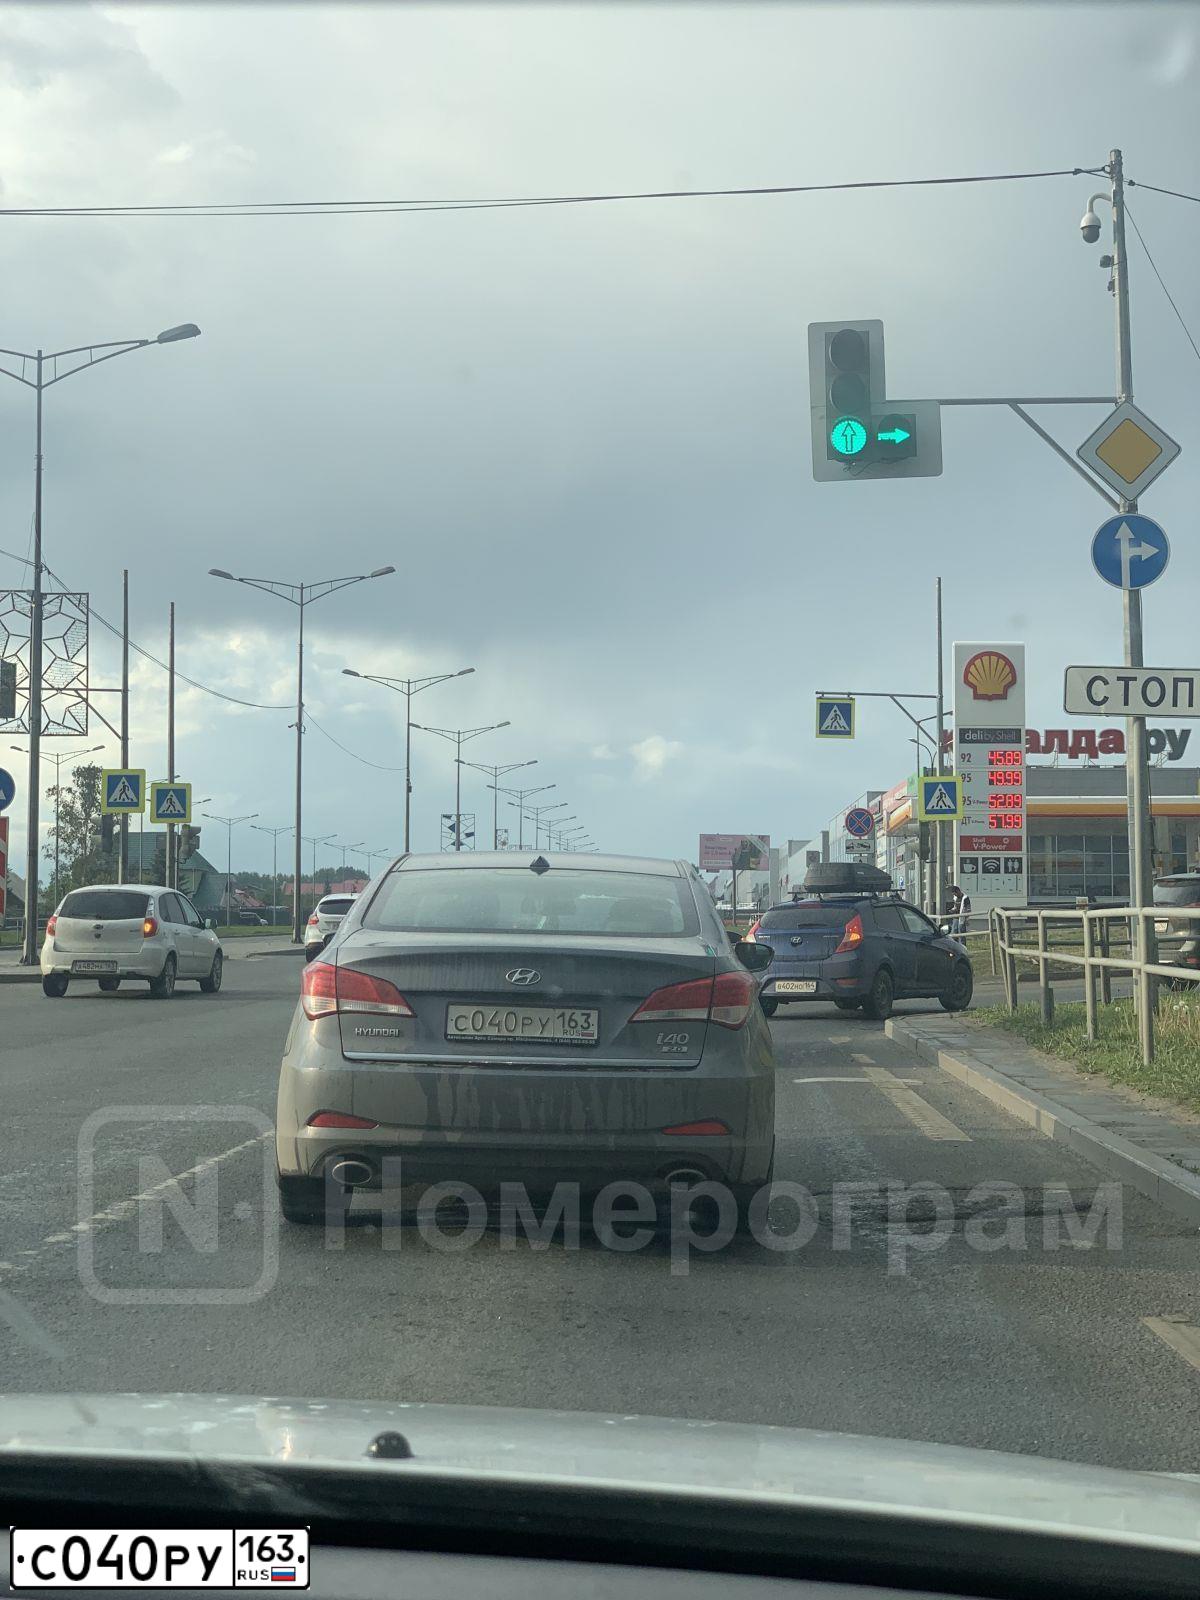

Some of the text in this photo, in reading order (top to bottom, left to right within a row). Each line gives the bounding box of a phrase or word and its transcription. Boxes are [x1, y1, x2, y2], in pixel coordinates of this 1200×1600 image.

[1086, 675, 1194, 708] СТОП
[965, 731, 983, 740] deli
[961, 753, 972, 763] 92
[961, 773, 972, 783] 95
[454, 1010, 592, 1034] С040РУ 163
[355, 1027, 399, 1037] HYUNDAI
[562, 1029, 581, 1037] RUS
[656, 1032, 690, 1045] i40
